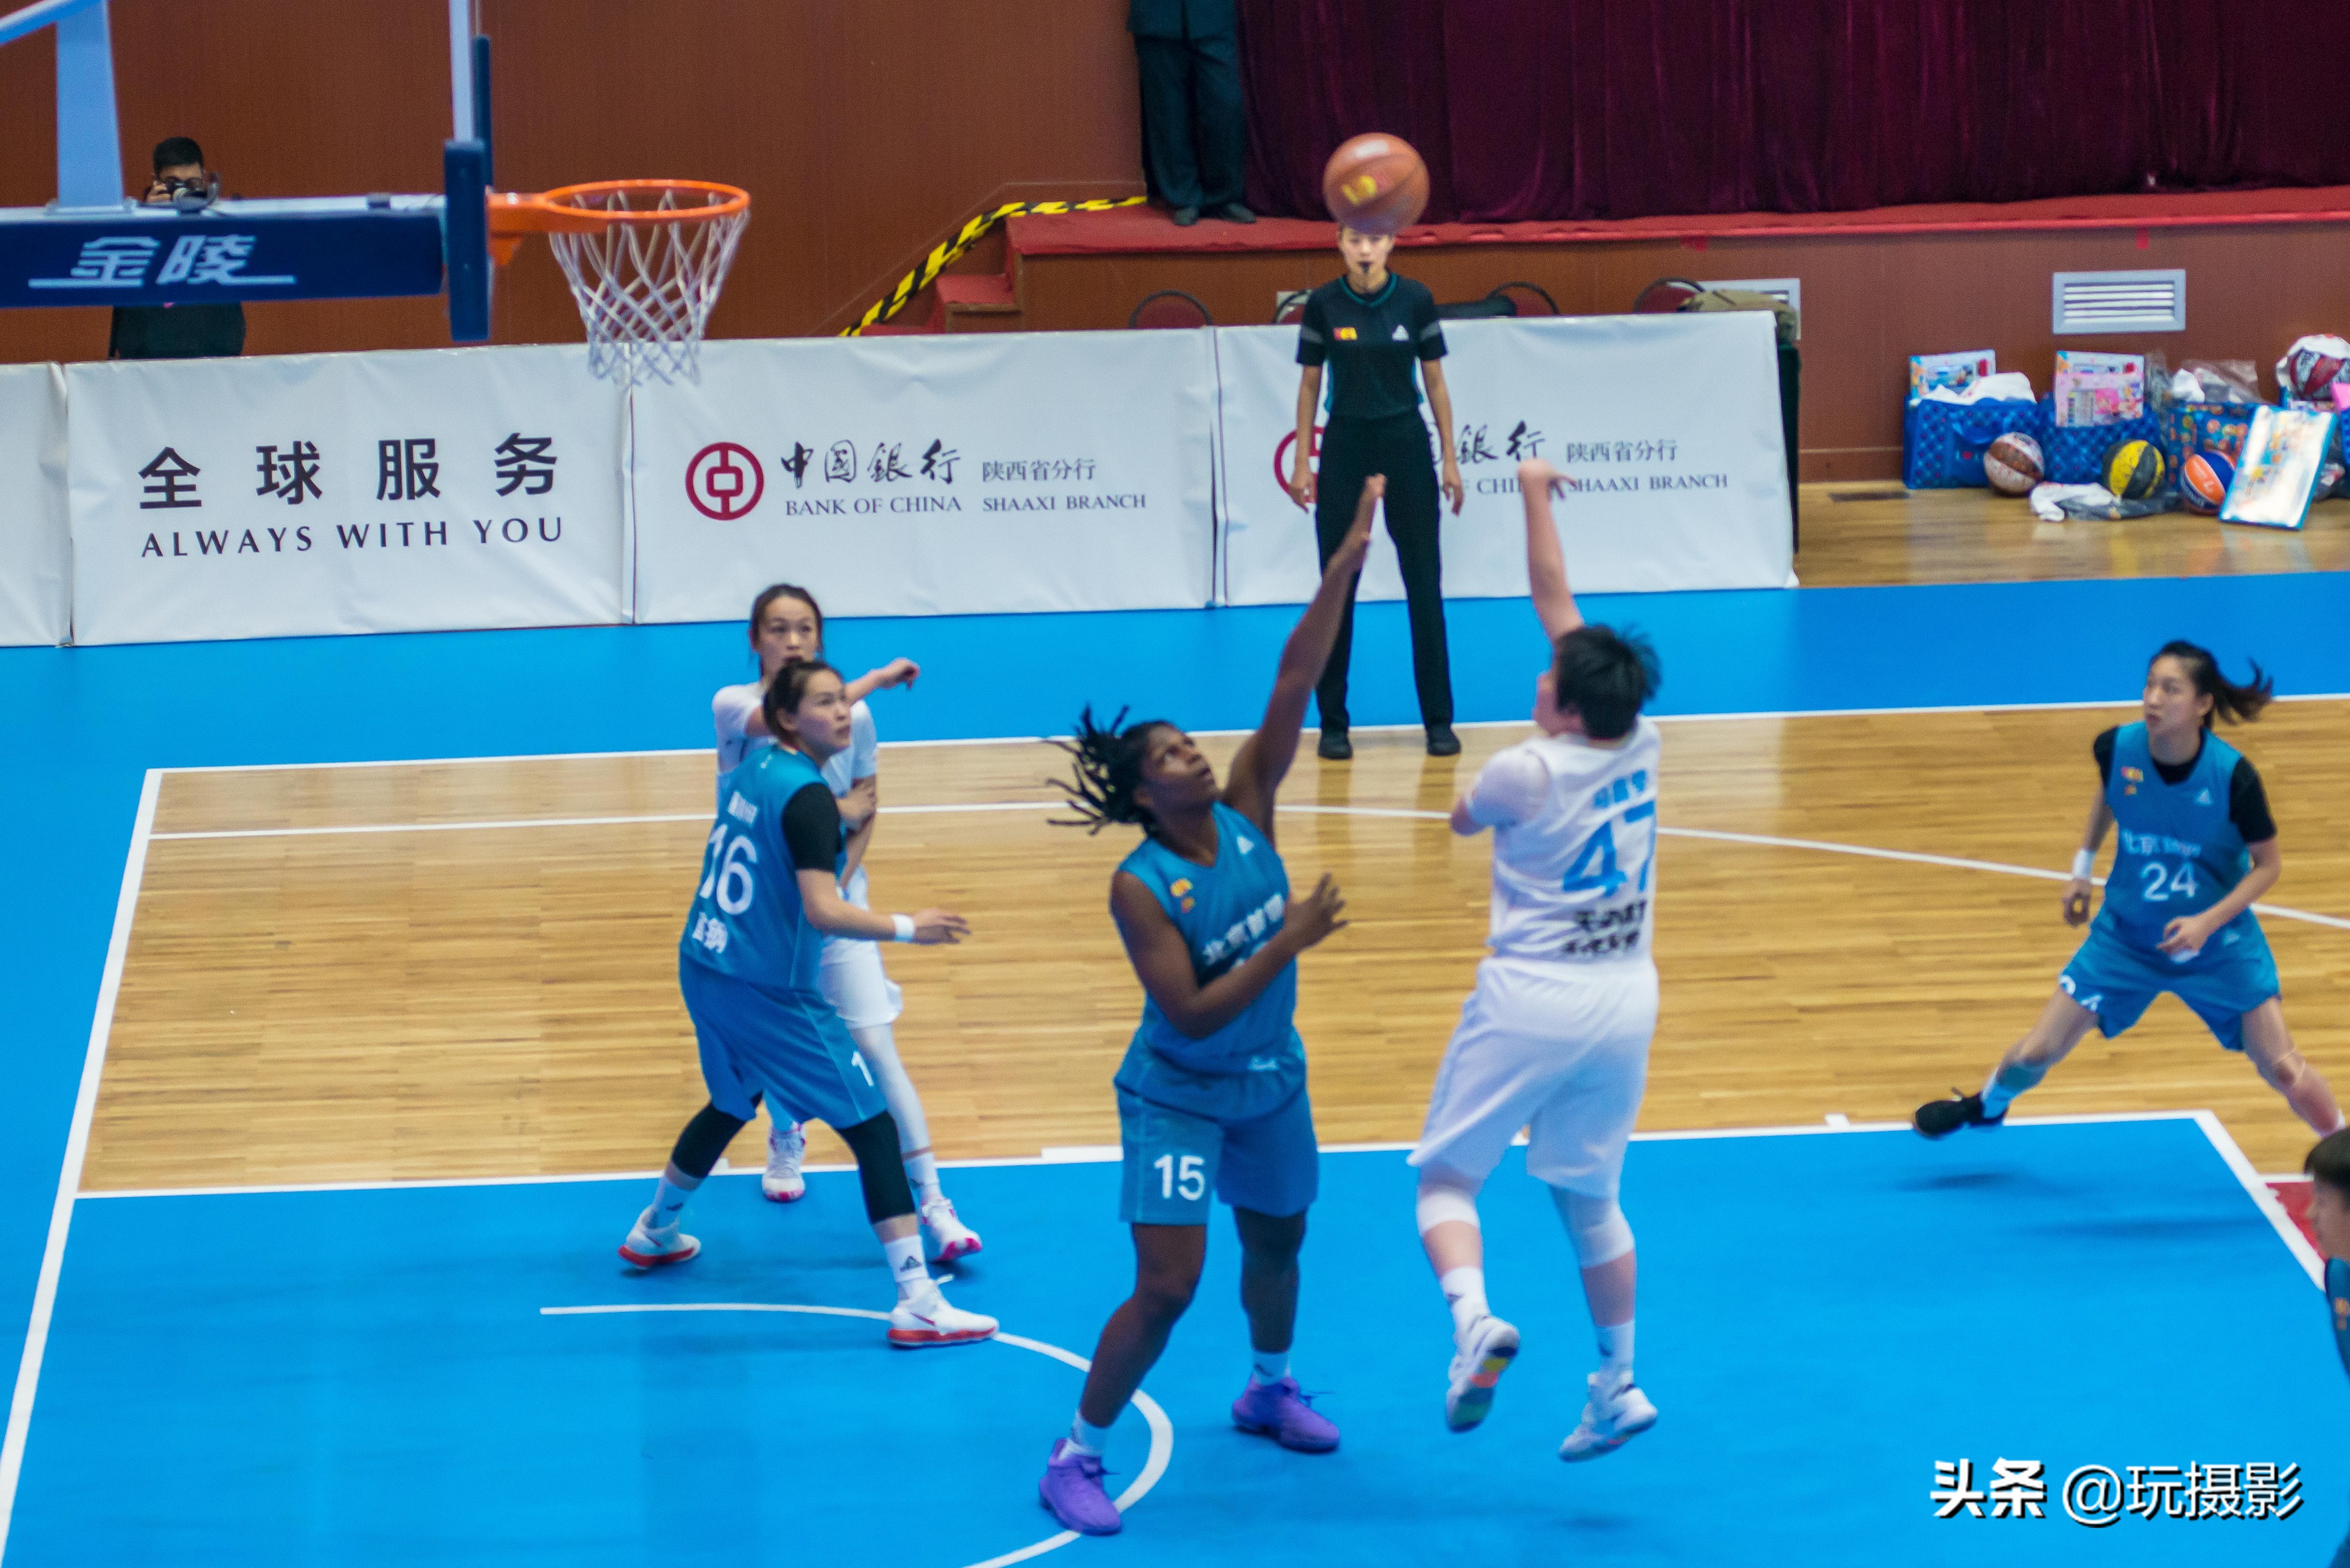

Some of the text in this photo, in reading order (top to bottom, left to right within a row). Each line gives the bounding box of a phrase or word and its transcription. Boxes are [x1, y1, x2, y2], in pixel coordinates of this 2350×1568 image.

[28, 234, 297, 288] 金陵
[138, 432, 558, 509] 全球服务
[982, 458, 1096, 482] 陕西省分行
[1476, 477, 1523, 495] CHI
[1649, 473, 1728, 491] BRANCH
[785, 493, 1147, 516] BANK OF CHINA SHAAXI BRANCH
[140, 516, 563, 558] ALWAYS WITH YOU
[699, 823, 758, 915] 16
[1562, 800, 1656, 898] 47
[2140, 862, 2199, 902] 24
[1154, 1154, 1205, 1201] 15
